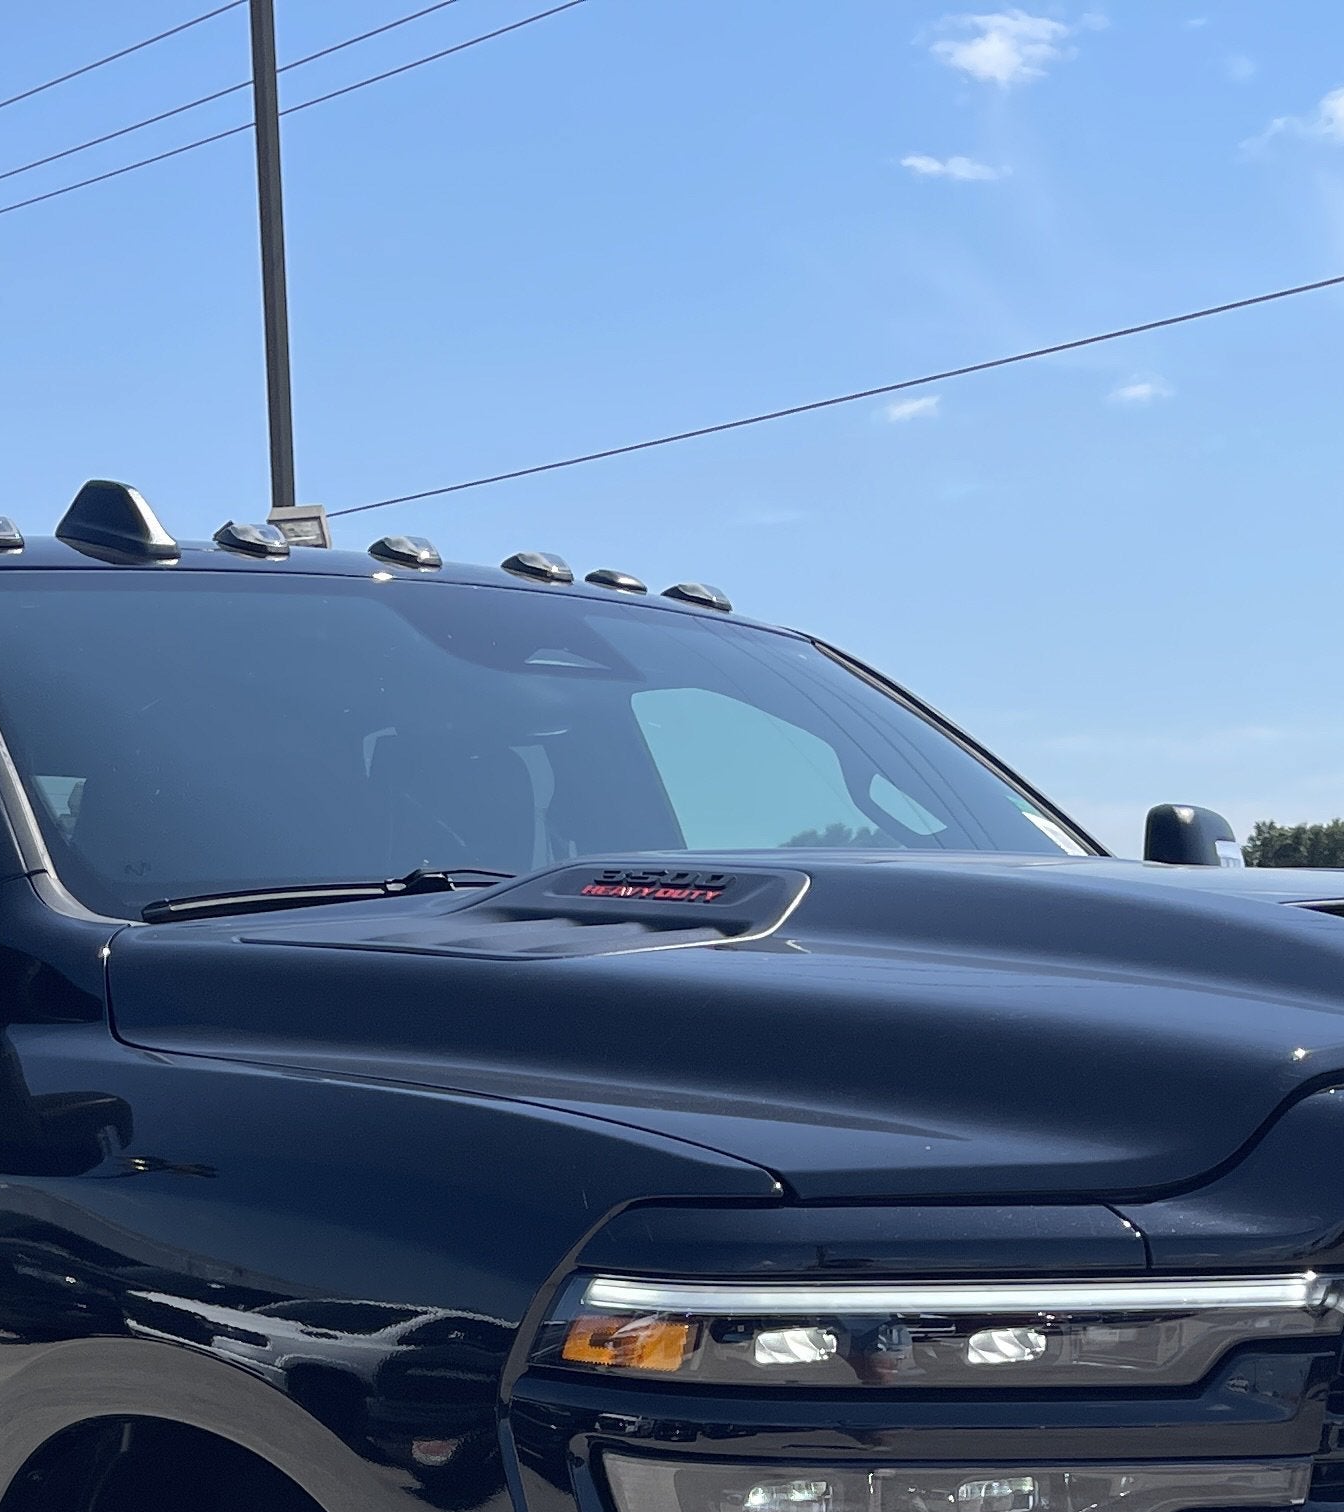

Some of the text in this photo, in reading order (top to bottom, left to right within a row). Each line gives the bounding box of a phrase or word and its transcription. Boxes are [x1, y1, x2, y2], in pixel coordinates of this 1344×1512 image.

[594, 870, 735, 890] 3500
[581, 884, 724, 904] HEAVY DUTY
